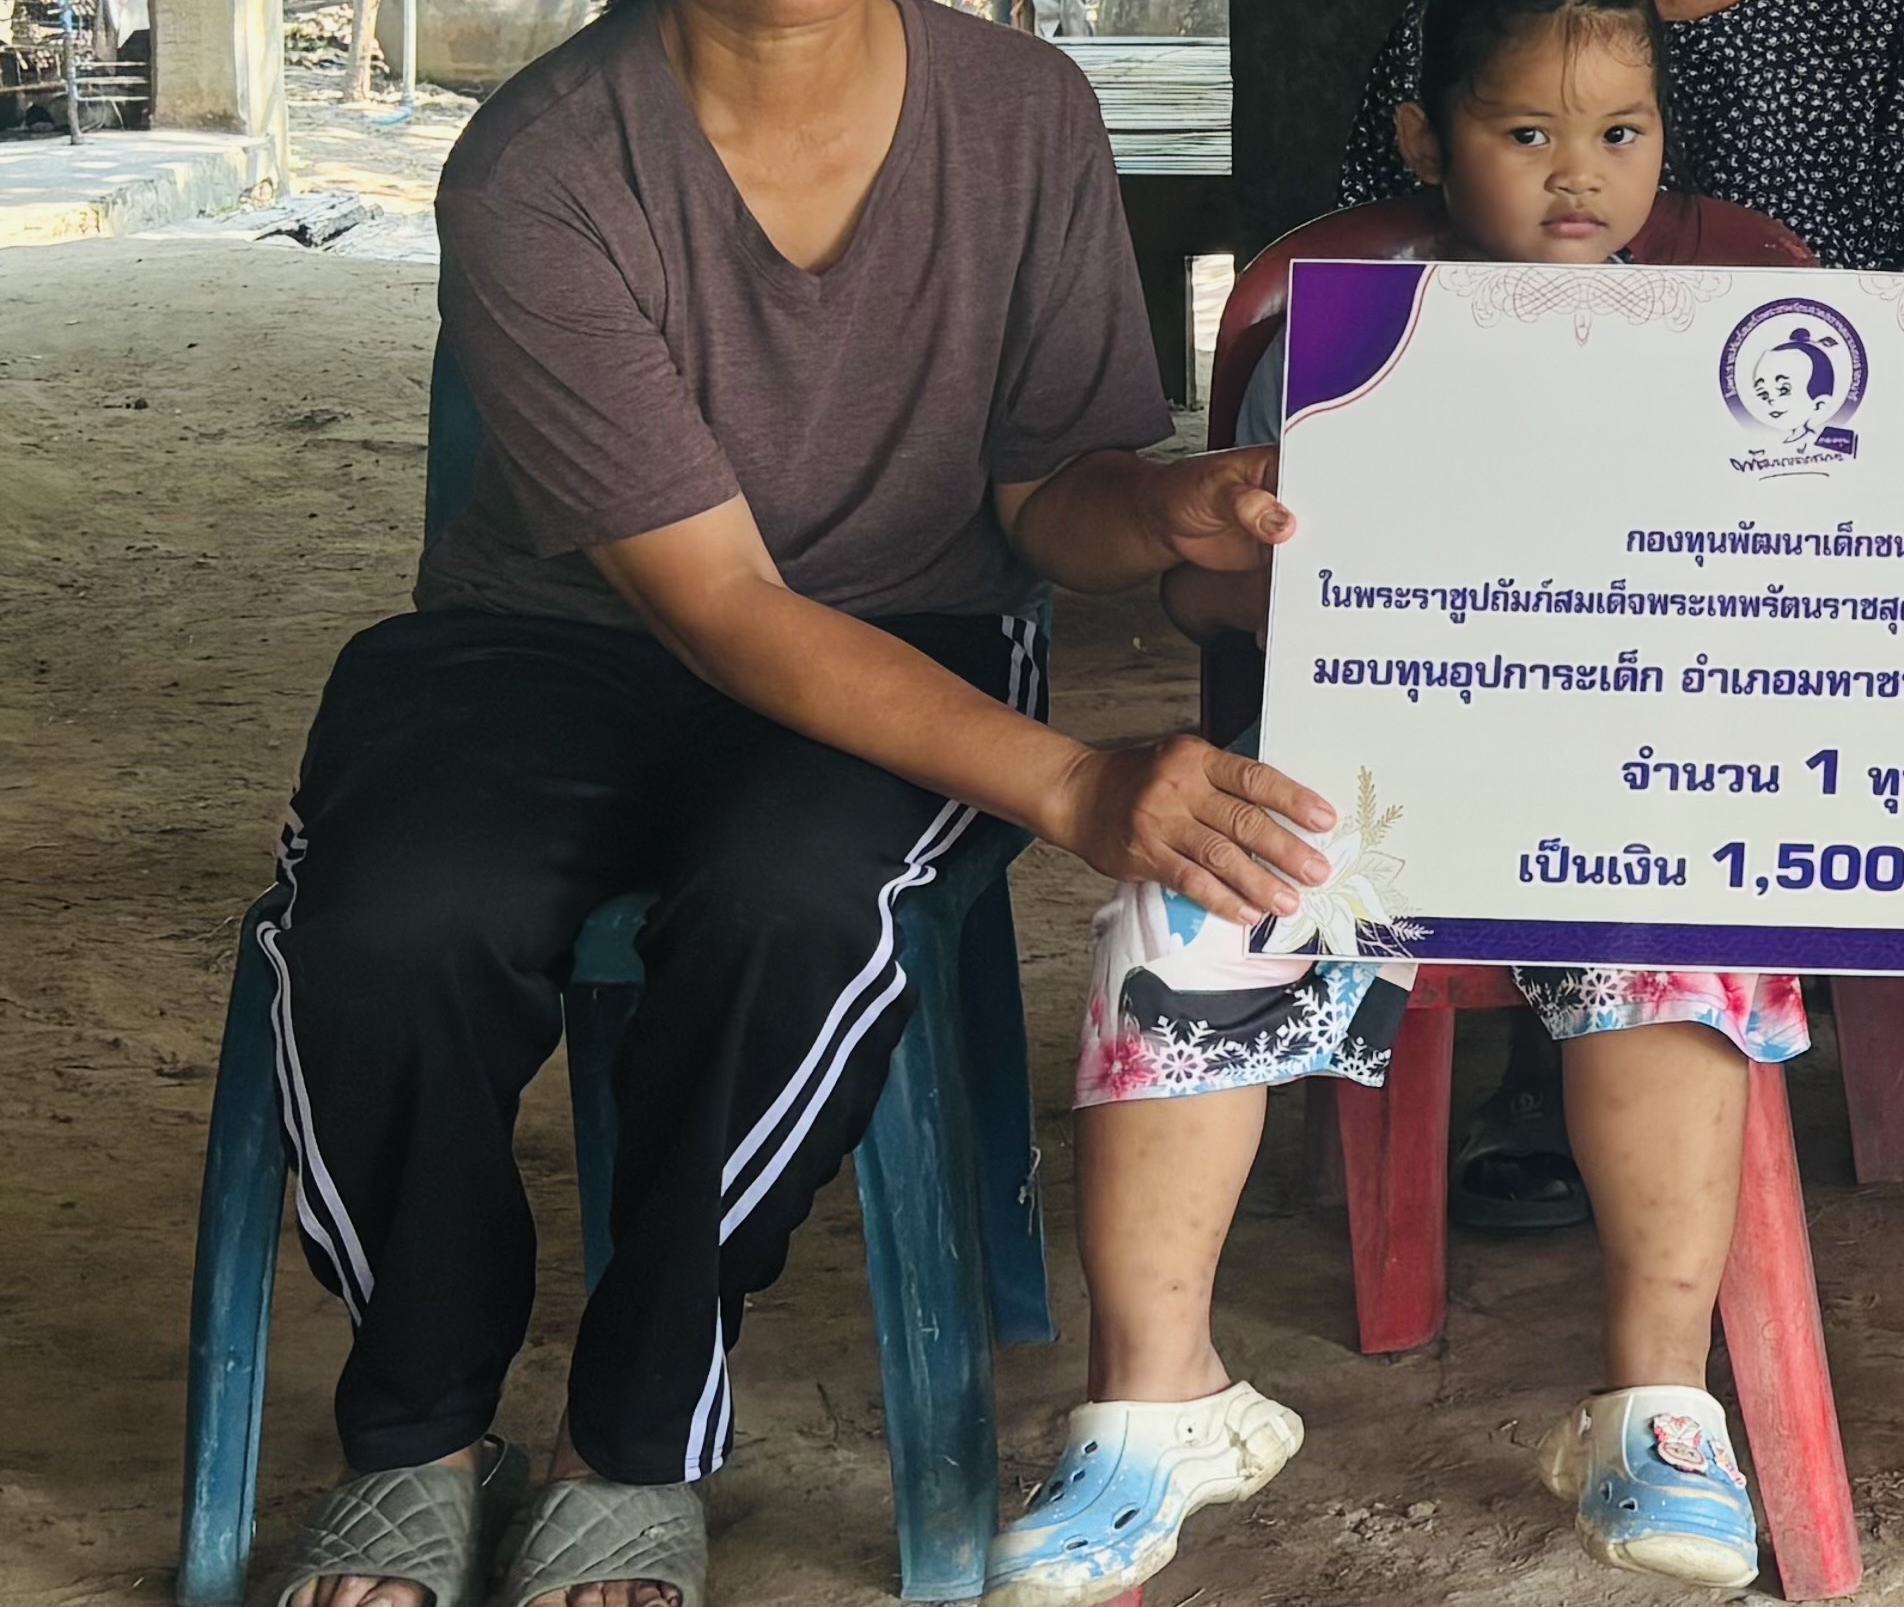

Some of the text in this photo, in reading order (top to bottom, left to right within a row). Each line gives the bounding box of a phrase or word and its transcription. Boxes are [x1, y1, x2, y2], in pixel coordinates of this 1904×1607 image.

[1313, 649, 1664, 705] มอบทุนอุปการะเด็ก
[1621, 745, 1781, 794] จำนวน
[1805, 749, 1840, 796] 1
[1519, 837, 1688, 886] เป็นเงิน
